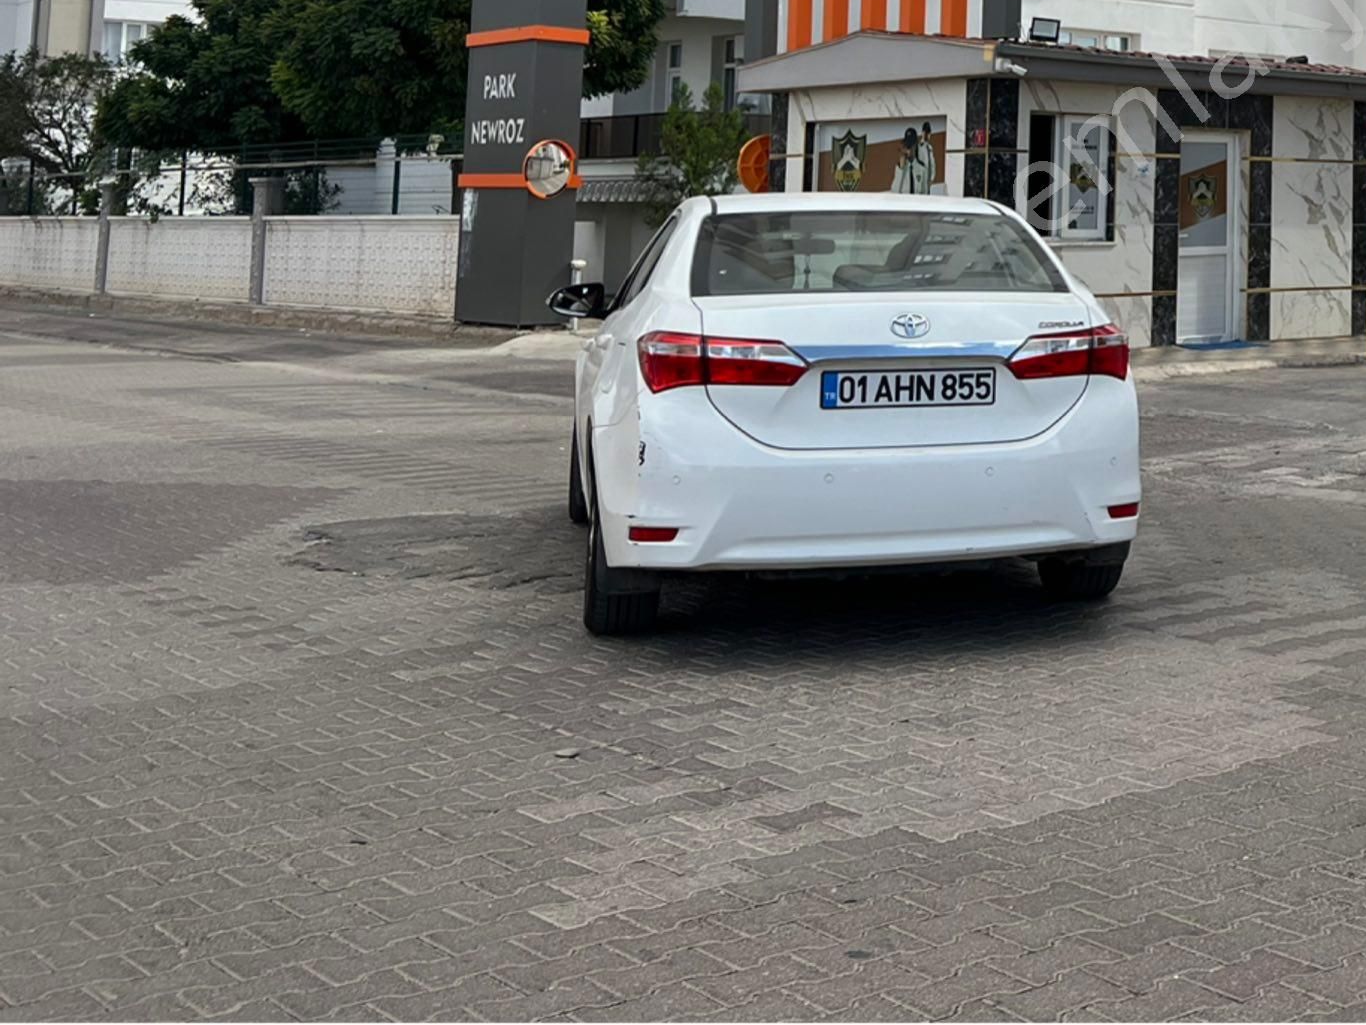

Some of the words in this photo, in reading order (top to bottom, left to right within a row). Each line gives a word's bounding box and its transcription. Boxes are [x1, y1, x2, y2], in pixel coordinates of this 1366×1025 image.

[483, 72, 517, 100] PARK
[471, 118, 525, 145] NEWROZ
[839, 375, 867, 403] 01
[874, 374, 936, 402] AHN
[941, 372, 991, 400] 855
